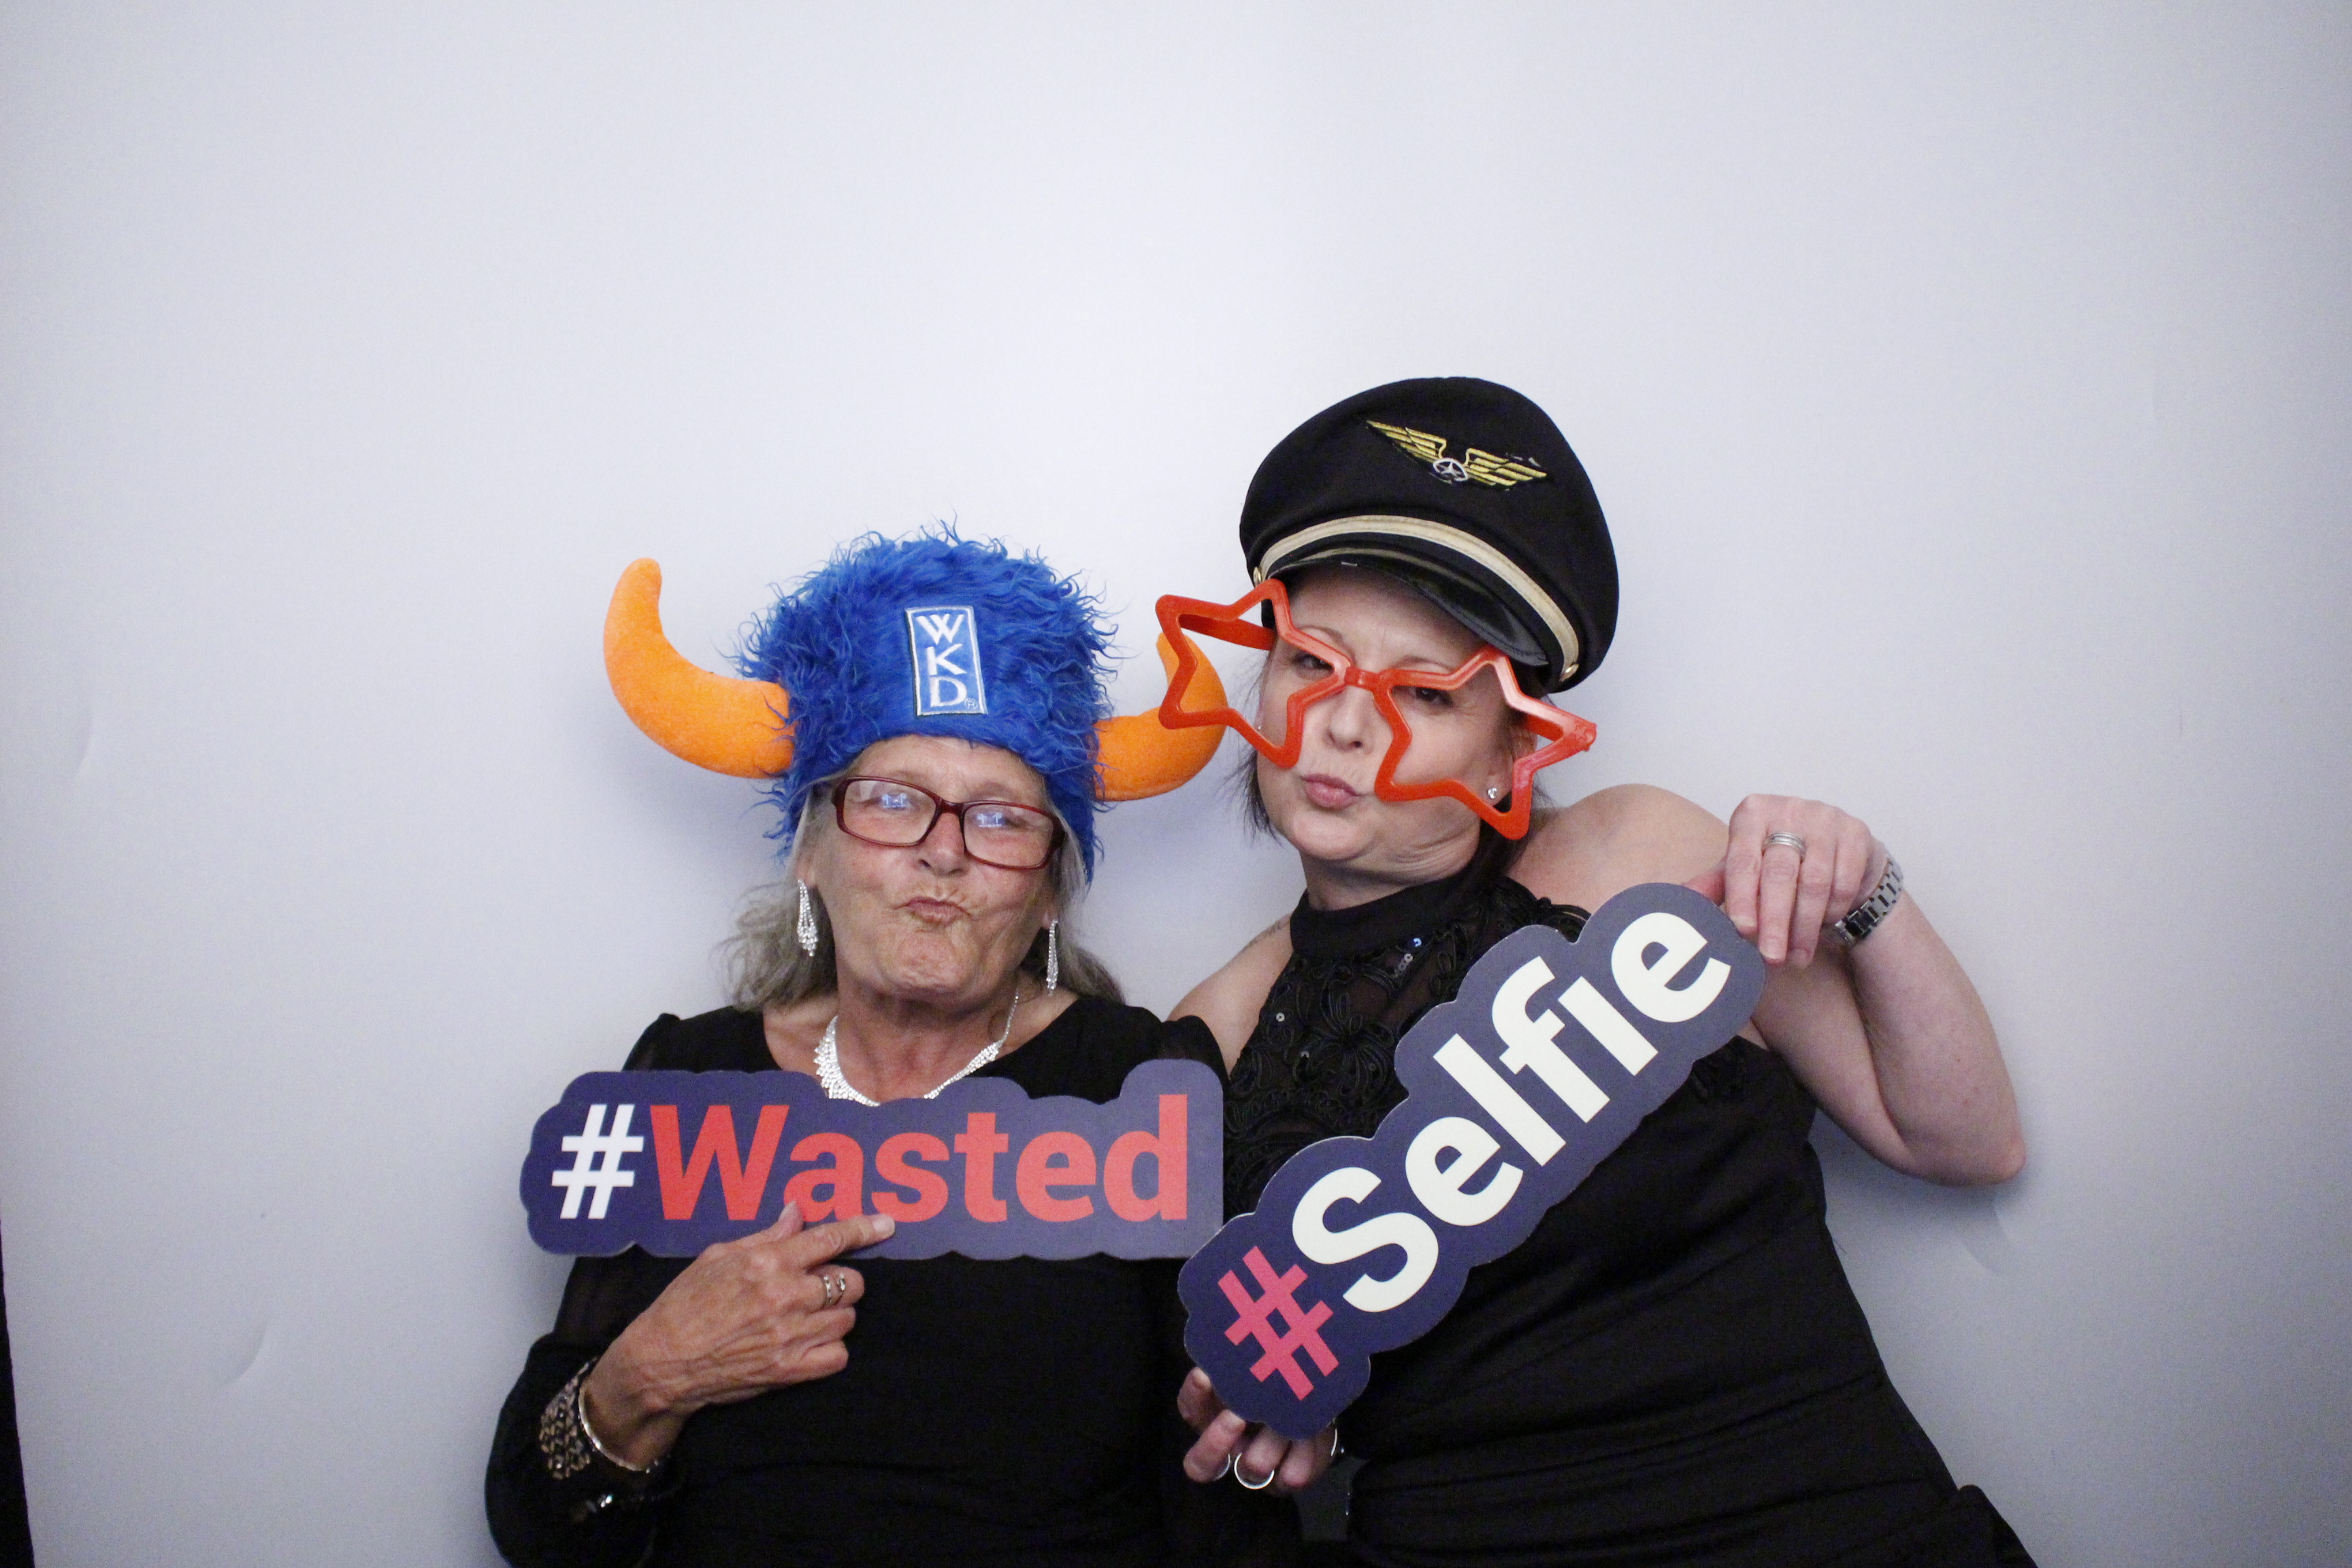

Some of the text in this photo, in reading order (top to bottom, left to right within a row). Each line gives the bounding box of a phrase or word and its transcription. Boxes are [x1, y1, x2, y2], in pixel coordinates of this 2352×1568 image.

[915, 612, 968, 708] WKD
[551, 1094, 1188, 1224] #Wasted
[1218, 911, 1731, 1401] #Selfie
